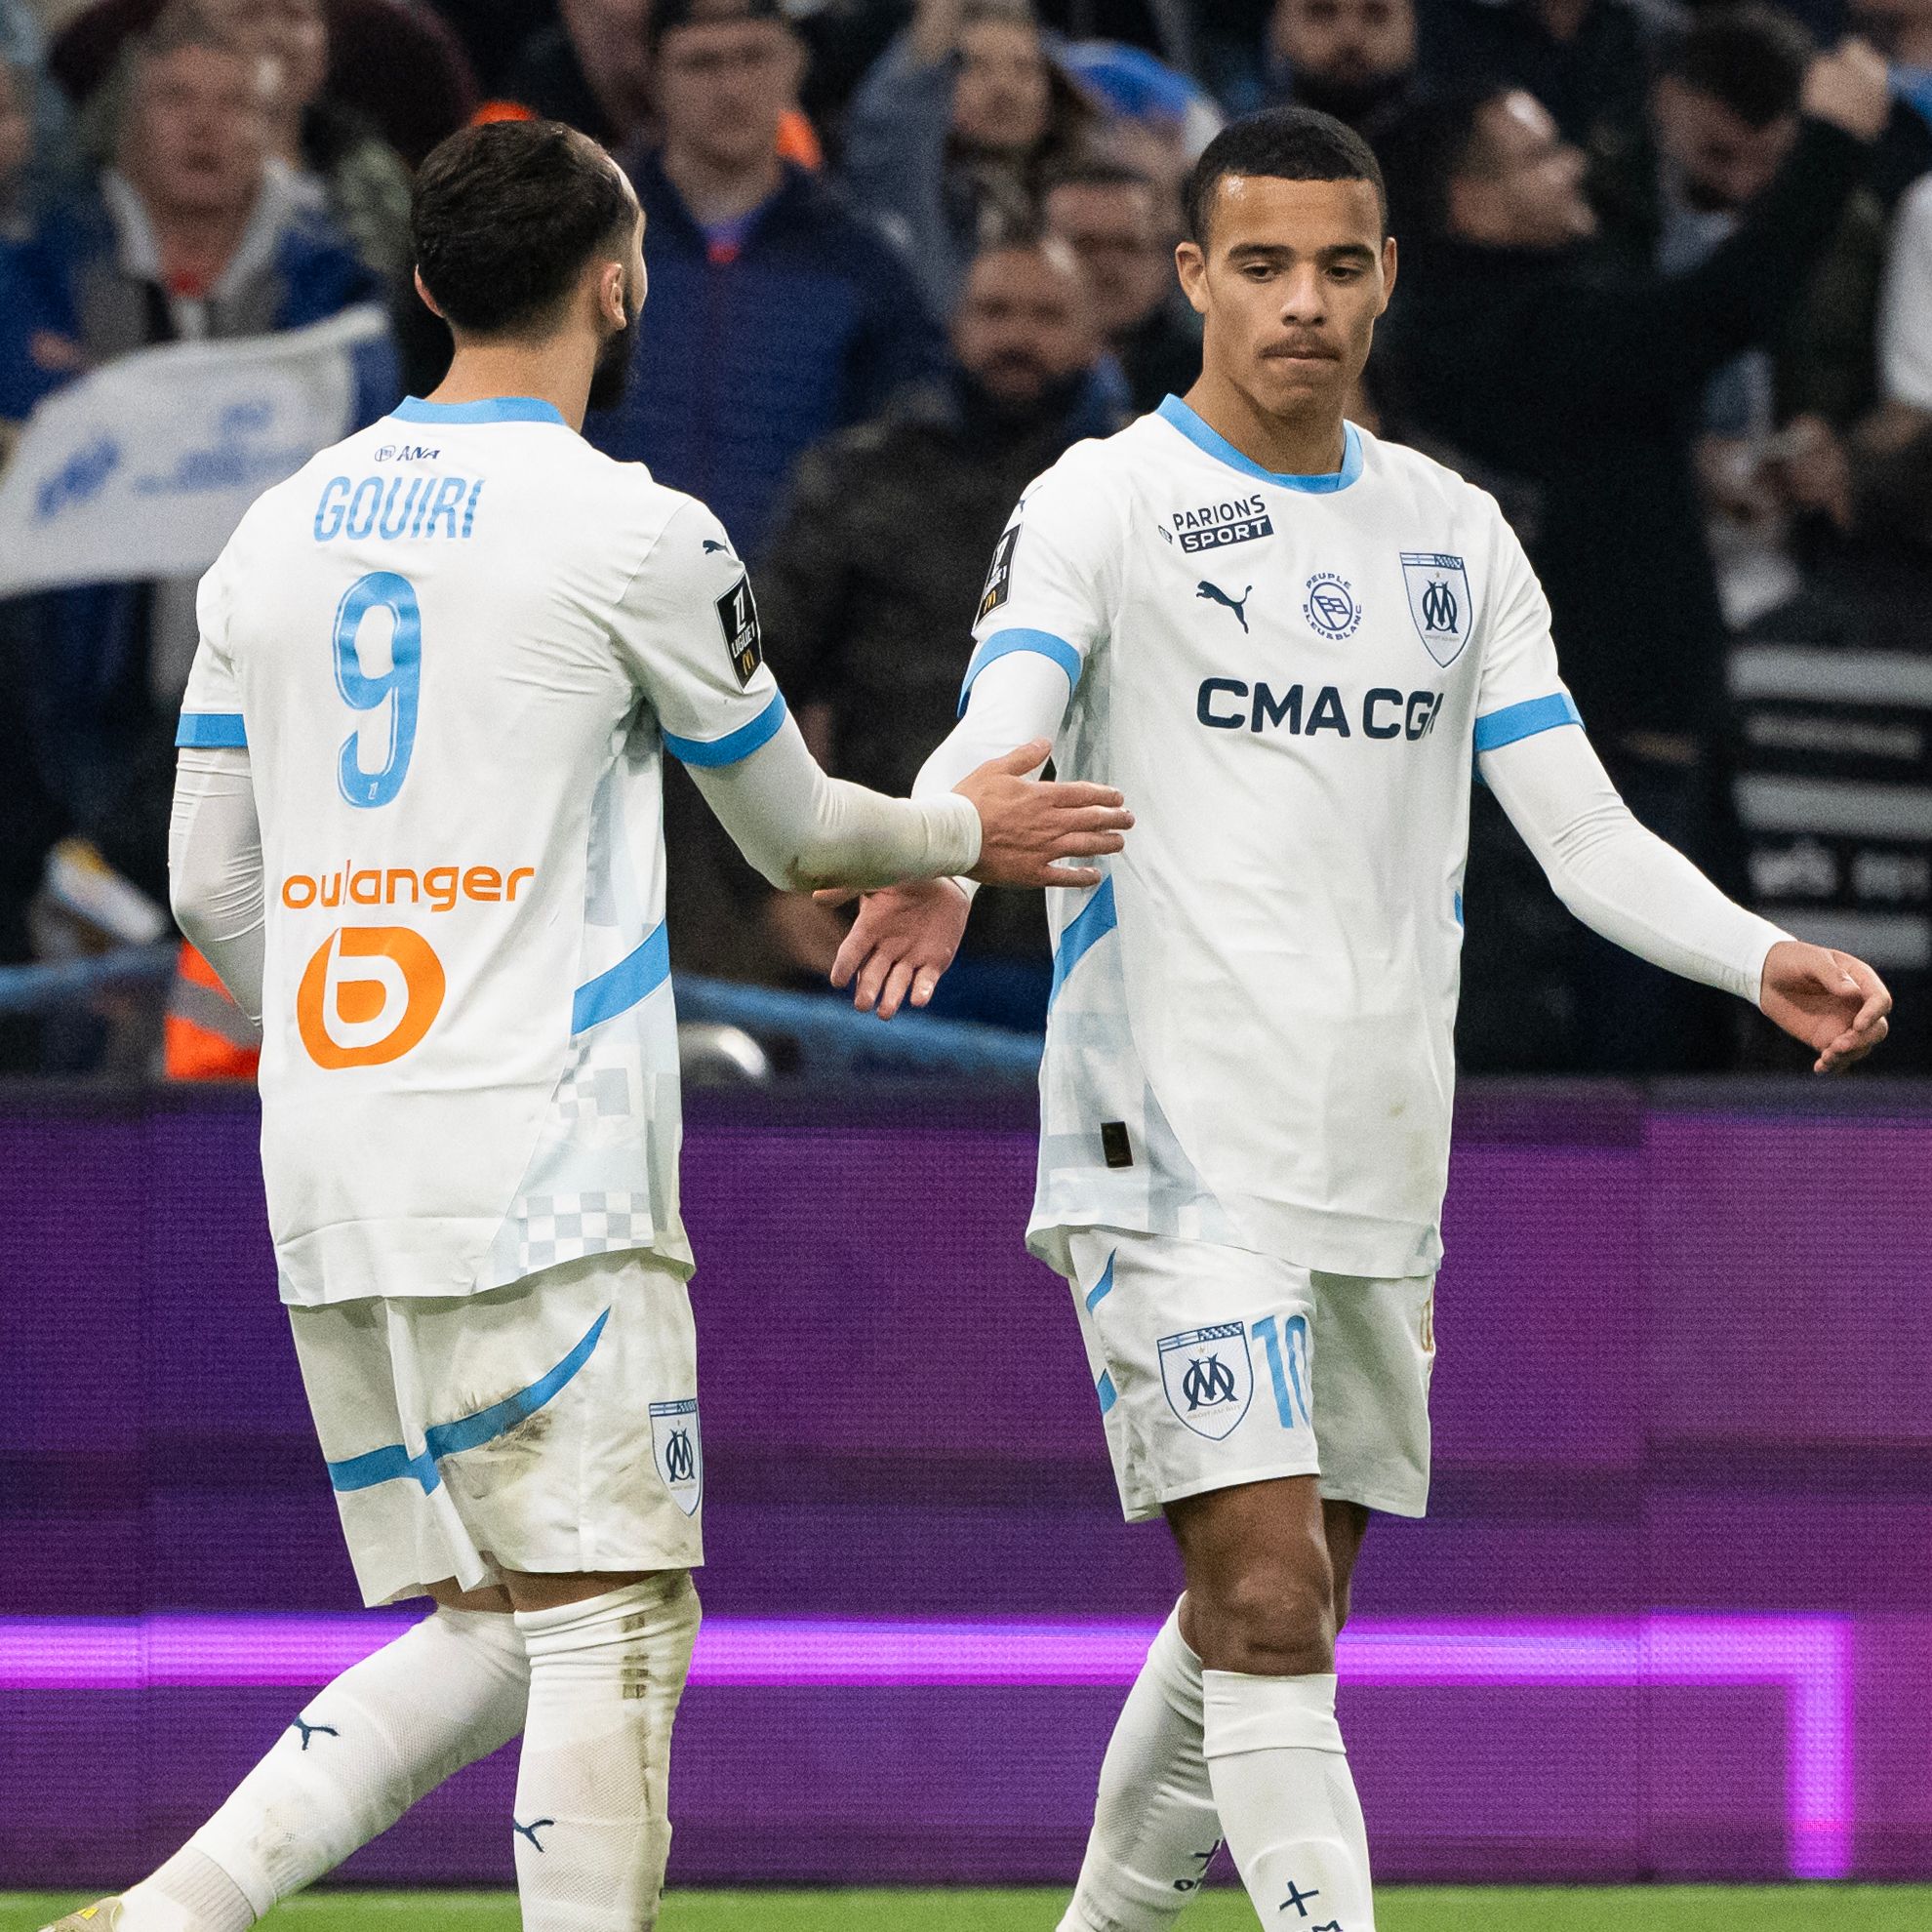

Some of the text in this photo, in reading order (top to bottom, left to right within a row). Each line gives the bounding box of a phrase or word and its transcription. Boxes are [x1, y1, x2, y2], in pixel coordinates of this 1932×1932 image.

[313, 475, 487, 543] GOUIRI
[1172, 494, 1267, 532] PARIONS
[1184, 518, 1268, 551] SPORT
[1305, 572, 1352, 590] PEUPLE
[332, 570, 423, 809] 9
[1196, 677, 1350, 738] CMA
[1251, 1314, 1312, 1429] 10
